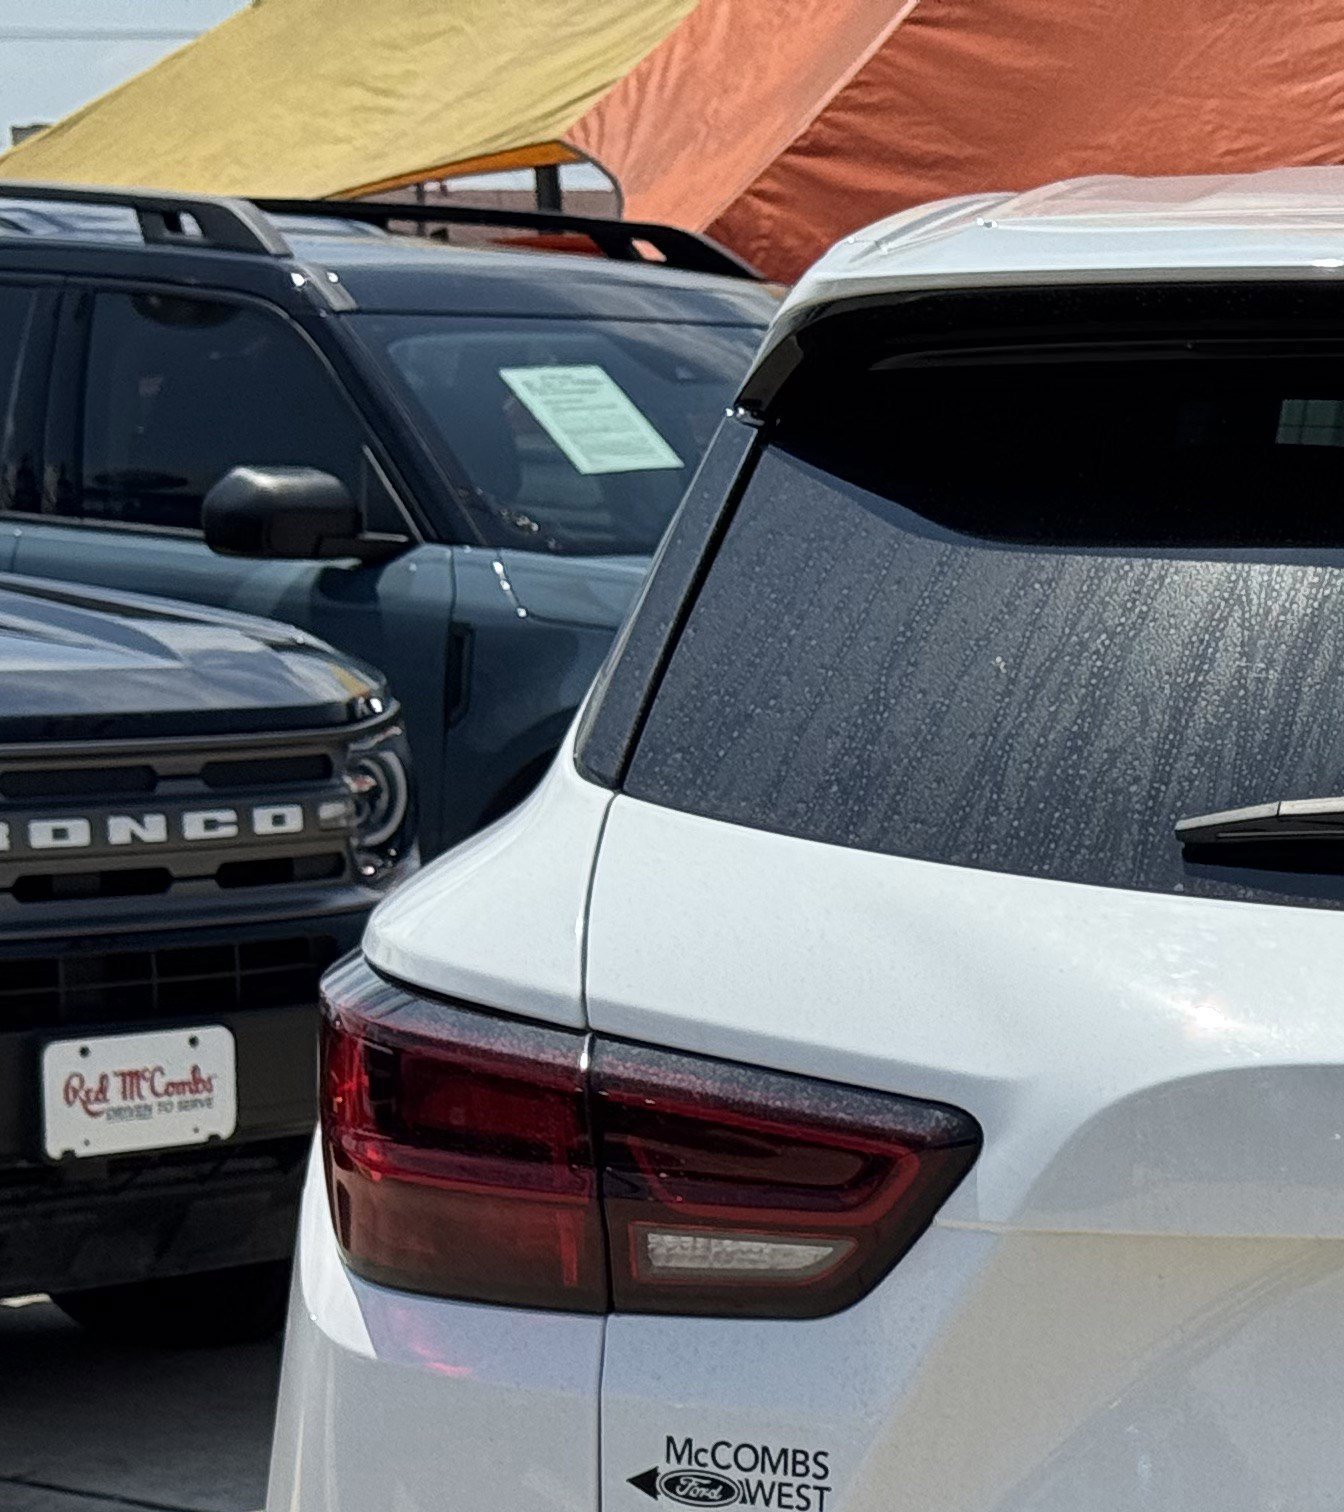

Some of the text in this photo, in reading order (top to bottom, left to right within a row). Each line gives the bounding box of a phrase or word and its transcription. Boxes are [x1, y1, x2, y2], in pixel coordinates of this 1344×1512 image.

[0, 803, 303, 851] ONCO
[63, 1063, 214, 1119] Red McCombs
[665, 1435, 830, 1481] McCOMBS
[675, 1476, 723, 1501] Ford
